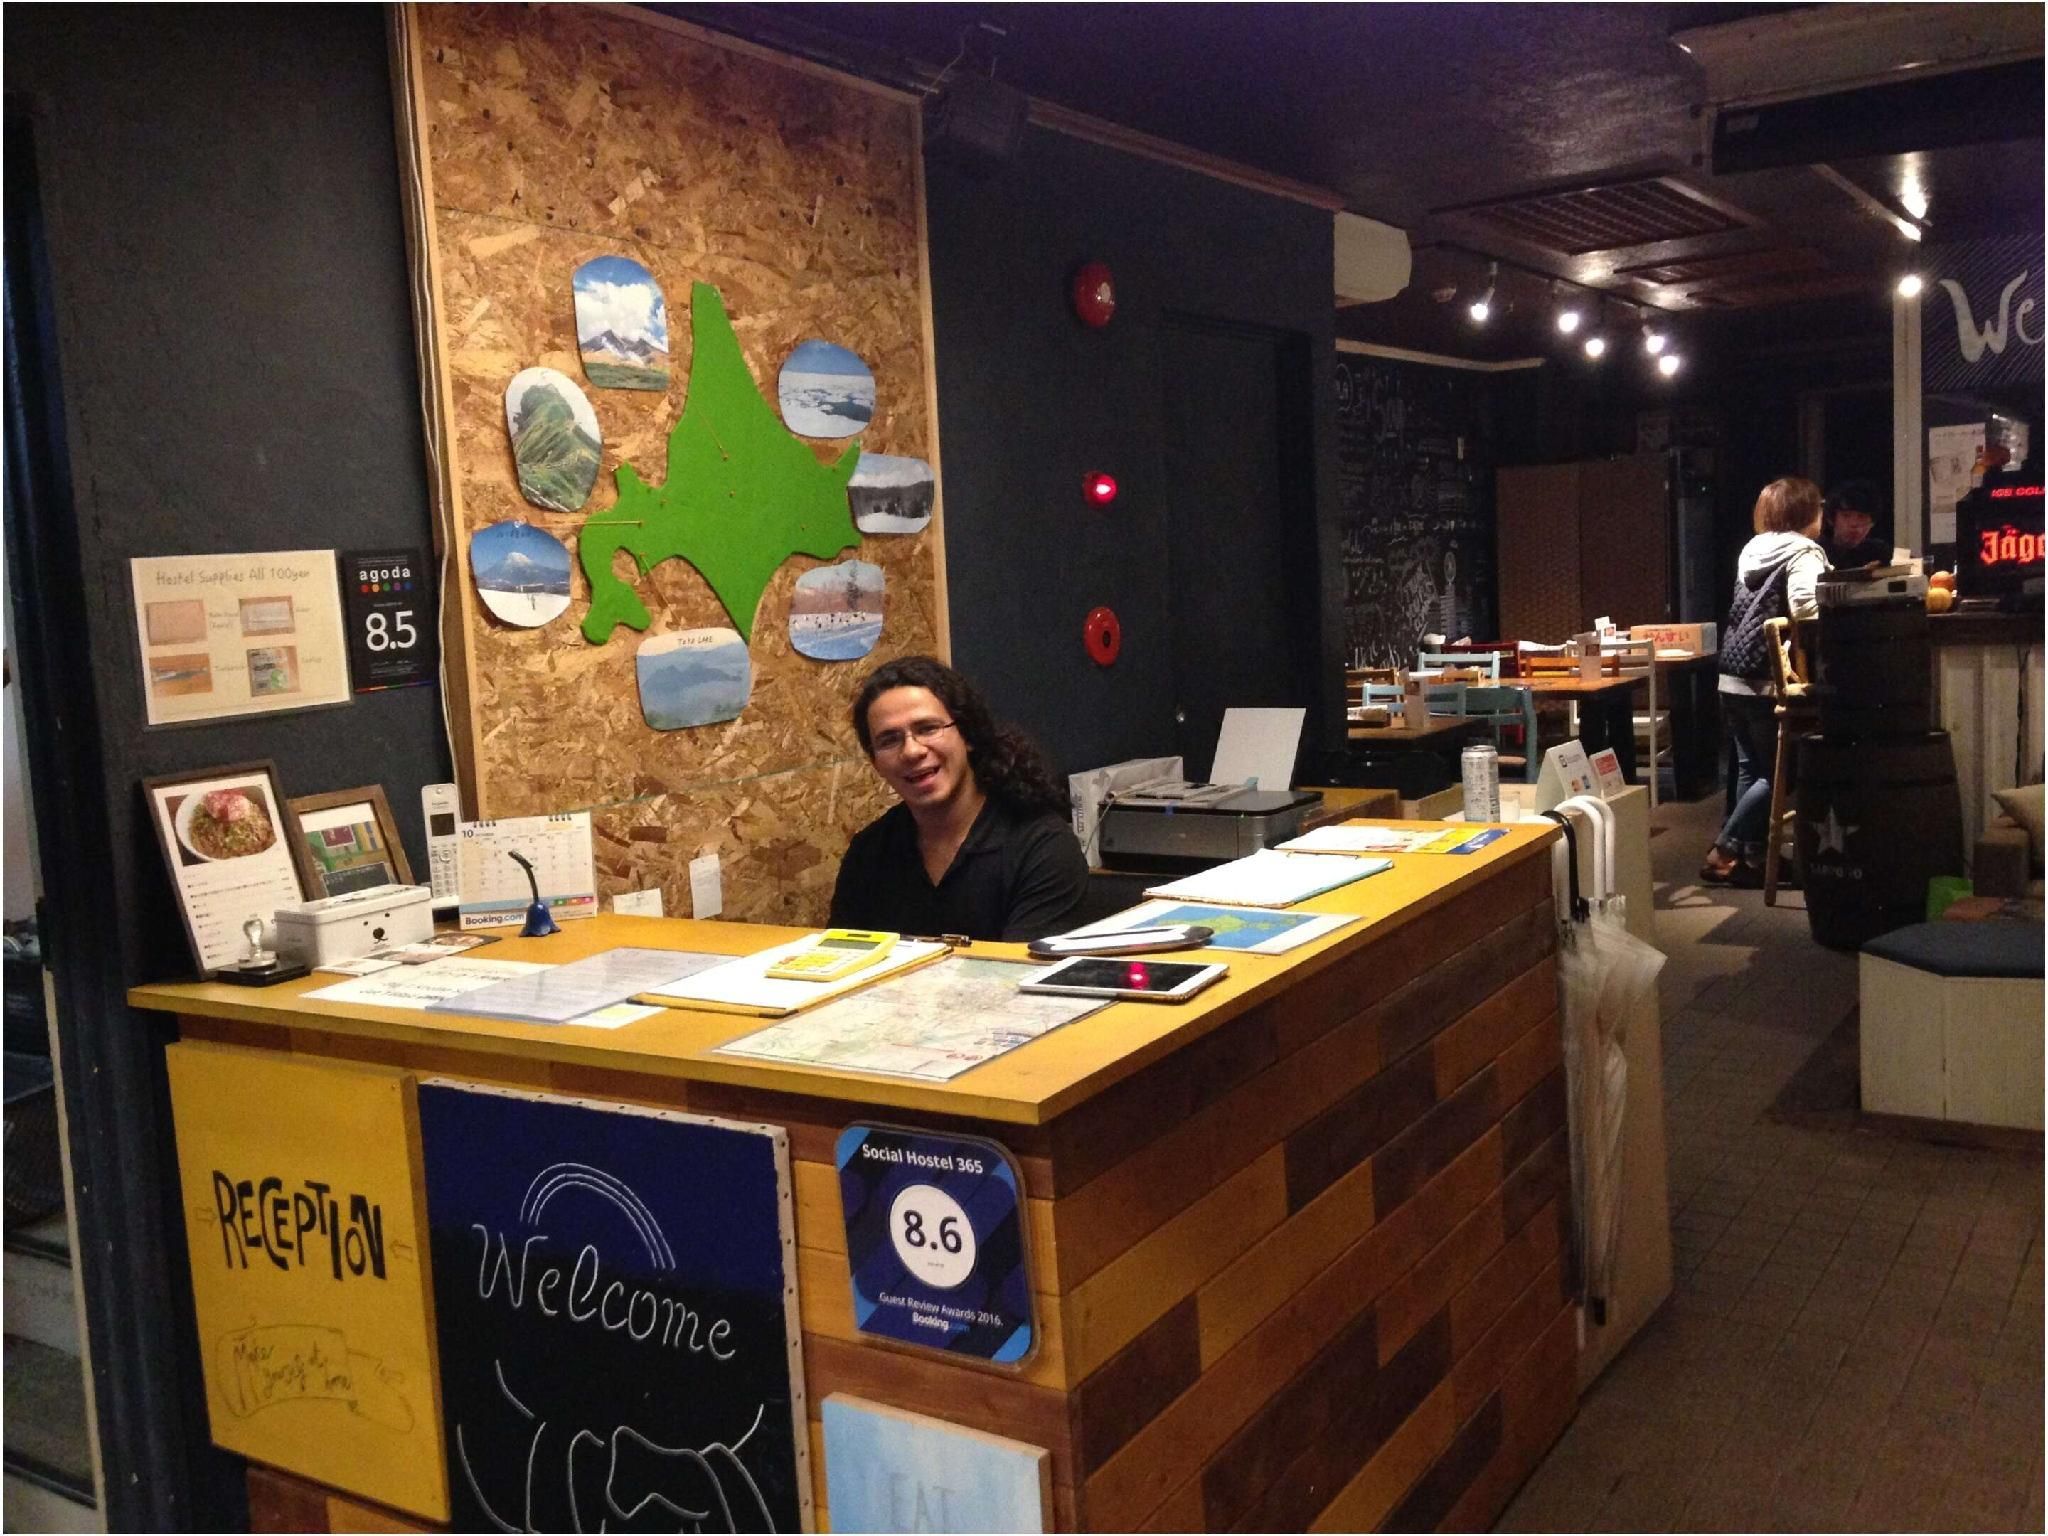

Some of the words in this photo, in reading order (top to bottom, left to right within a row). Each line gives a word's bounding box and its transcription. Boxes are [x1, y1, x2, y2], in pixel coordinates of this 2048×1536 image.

[156, 570, 194, 585] Hostel
[199, 569, 244, 584] Supplies
[249, 568, 265, 579] All
[359, 566, 411, 582] agoda
[366, 610, 417, 651] 8.5
[461, 829, 474, 838] 10
[465, 913, 525, 926] Booking.com
[862, 1143, 903, 1162] Social
[906, 1150, 953, 1170] Hostel
[956, 1157, 984, 1174] 365
[212, 1169, 387, 1281] RECEPTION
[903, 1209, 962, 1254] 8.6
[472, 1223, 737, 1361] Welcome
[879, 1292, 906, 1306] Guest
[907, 1297, 940, 1313] Review
[941, 1305, 976, 1321] Awards
